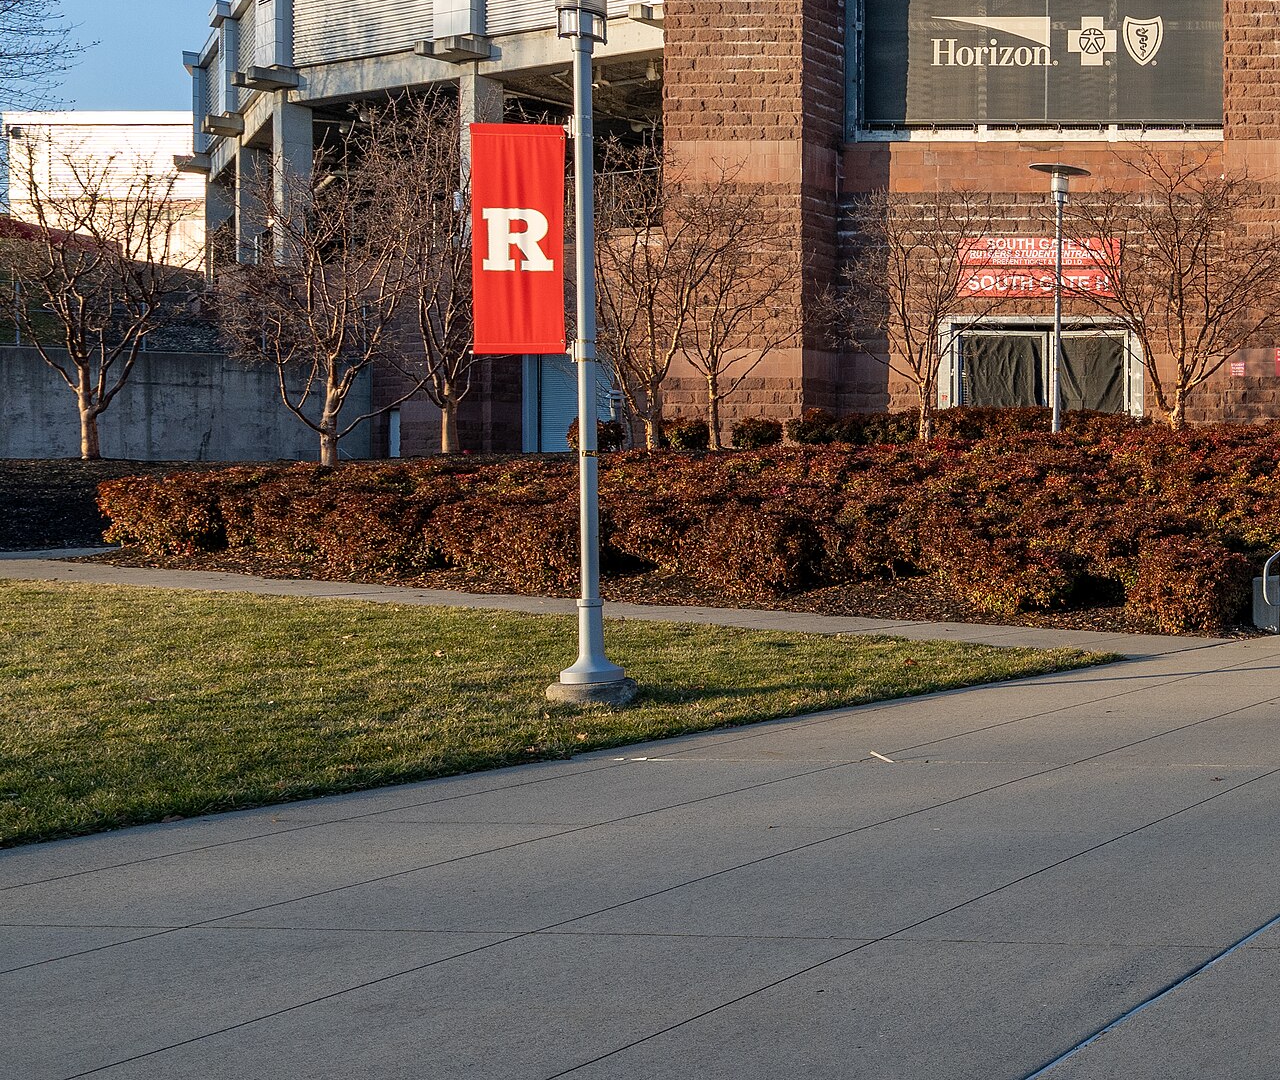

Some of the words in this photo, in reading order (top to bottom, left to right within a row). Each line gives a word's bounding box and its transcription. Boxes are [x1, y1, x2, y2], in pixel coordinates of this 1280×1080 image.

[931, 38, 1054, 66] Horizon
[482, 206, 554, 272] R
[986, 239, 1034, 250] SOUTH
[970, 249, 1011, 259] RUTGERS
[1015, 249, 1056, 259] STUDENT
[969, 275, 1033, 291] SOUTH
